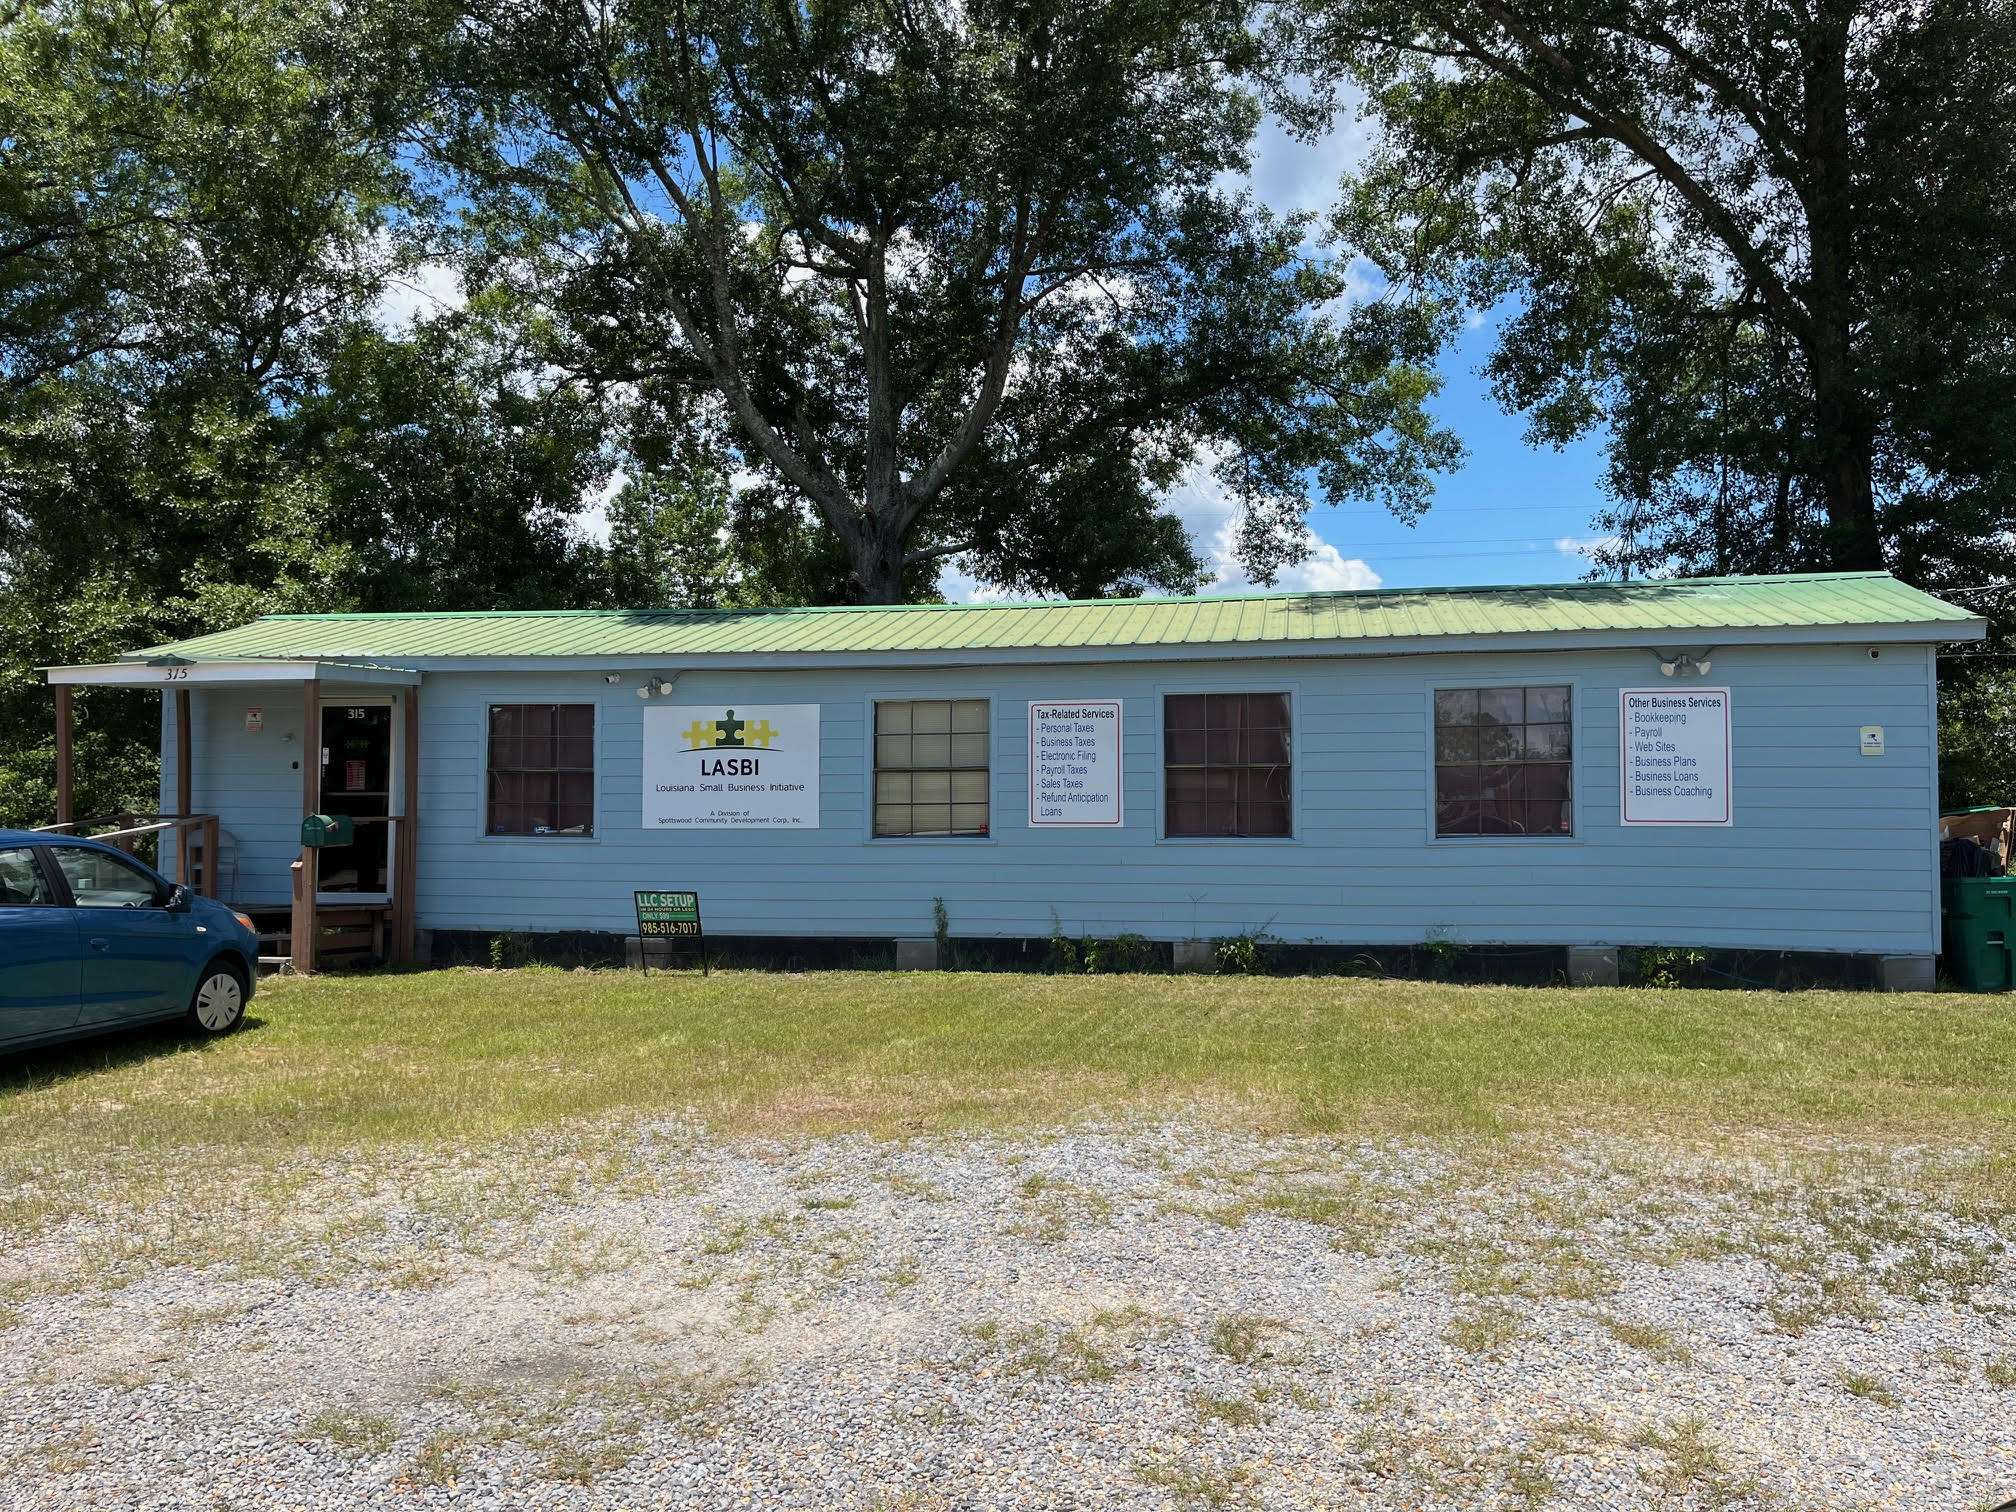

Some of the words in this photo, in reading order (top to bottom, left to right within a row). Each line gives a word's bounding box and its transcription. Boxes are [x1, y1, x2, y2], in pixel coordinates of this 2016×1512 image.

[164, 668, 187, 680] 315
[1629, 698, 1650, 708] Other
[1652, 698, 1686, 708] Business
[1688, 697, 1721, 708] Services
[347, 709, 366, 719] 315
[1036, 709, 1080, 719] Tax-Related
[1082, 709, 1115, 719] Services
[1634, 712, 1686, 724] Bookkeeping
[1041, 723, 1072, 733] Personal
[1074, 723, 1094, 732] Taxes
[1634, 727, 1662, 739] Payroll
[1041, 737, 1073, 747] Business
[1074, 737, 1095, 747] Taxes
[1634, 741, 1653, 752] Web
[1656, 741, 1676, 752] Sites
[1041, 750, 1075, 761] Electronic
[1078, 750, 1096, 762] Filing
[1635, 756, 1671, 766] Business
[1673, 756, 1696, 766] Plans
[701, 759, 759, 776] LASBI
[1041, 764, 1065, 776] Payroll
[1067, 764, 1088, 775] Taxes
[1635, 771, 1671, 781] Business
[1674, 771, 1698, 781] Loans
[656, 784, 695, 792] Louisiana
[699, 783, 723, 792] Small
[728, 783, 765, 792] Business
[1041, 778, 1060, 788] Sales
[1063, 778, 1083, 788] Taxes
[1635, 786, 1672, 796] Business
[1674, 785, 1712, 798] Coaching
[1041, 792, 1066, 802] Refund
[1068, 792, 1108, 804] Anticipation
[1040, 806, 1062, 816] Loans
[638, 894, 658, 907] LLC
[660, 894, 694, 907] SETUP
[642, 923, 697, 934] 985-516-7017
